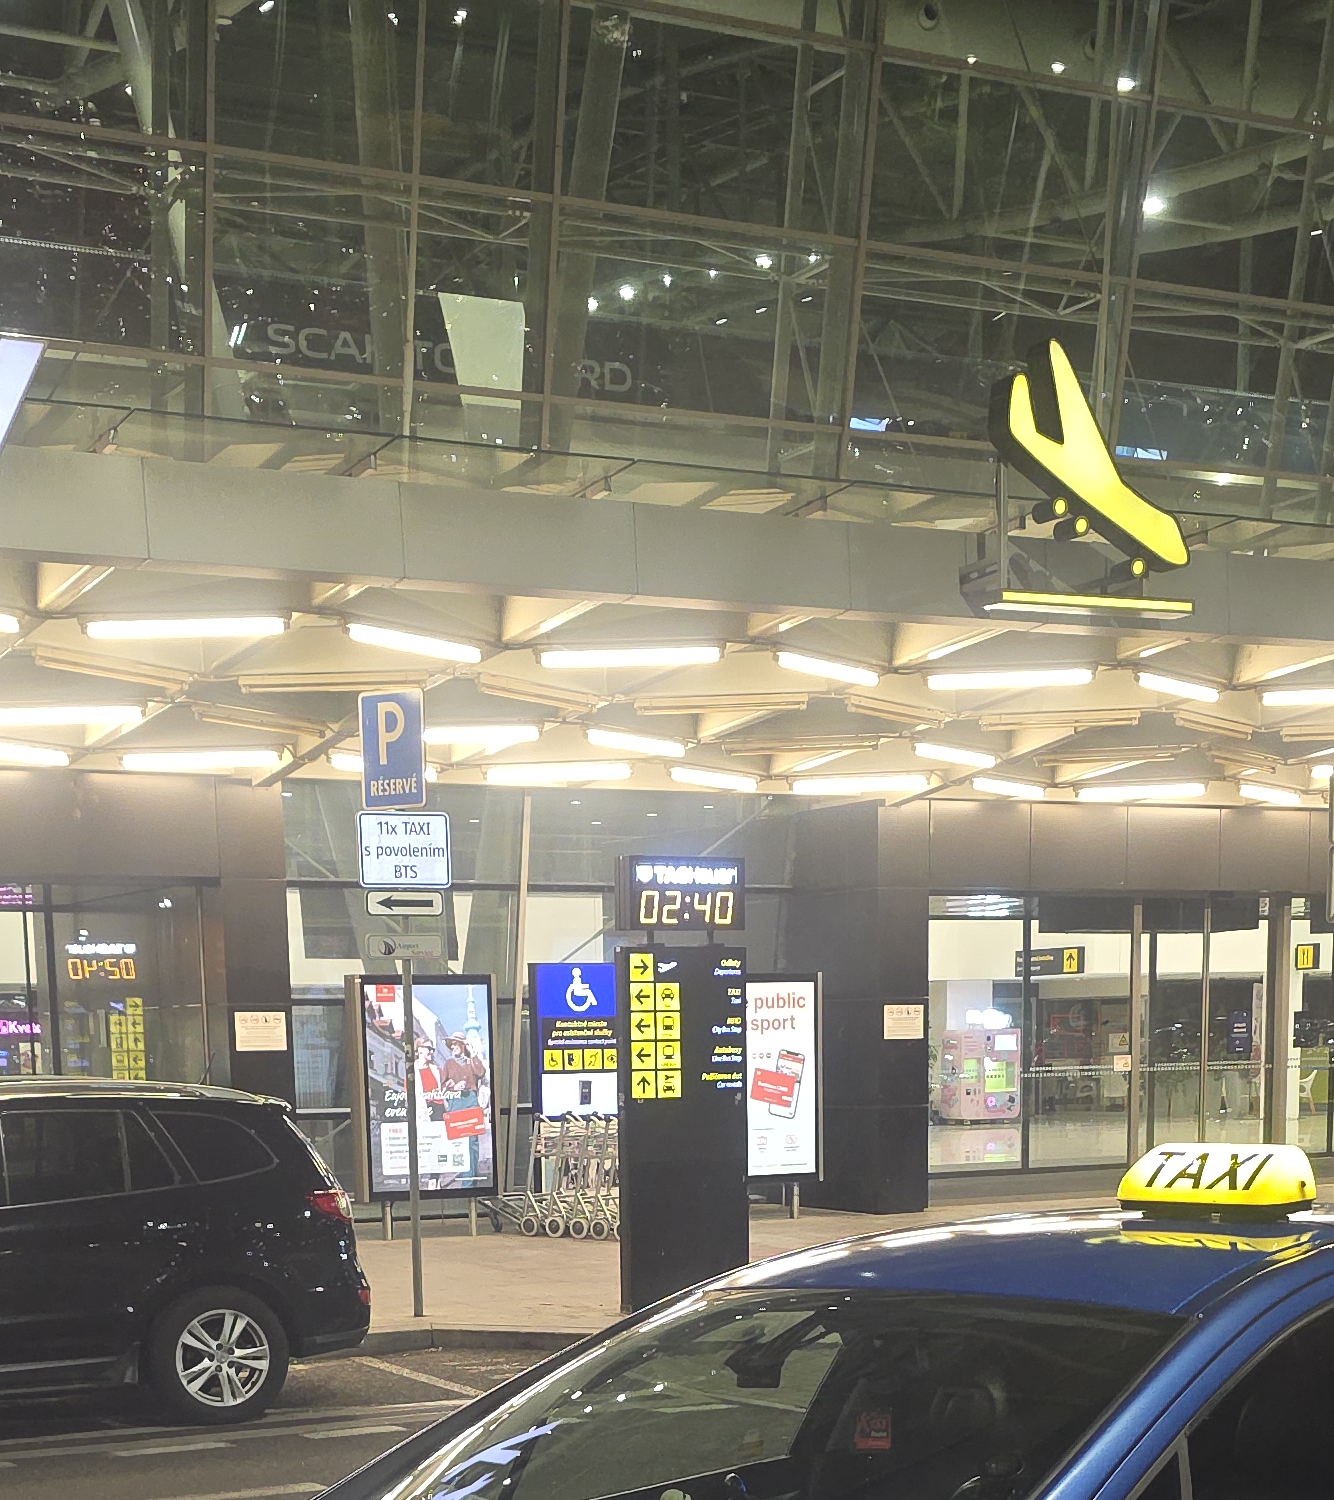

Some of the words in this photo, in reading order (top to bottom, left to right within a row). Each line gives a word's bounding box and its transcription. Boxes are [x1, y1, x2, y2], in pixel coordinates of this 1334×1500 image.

[377, 701, 405, 765] P
[370, 773, 418, 797] RÉSERVÉ
[377, 821, 398, 836] 11x
[402, 821, 431, 836] TAXI
[364, 846, 371, 857] s
[376, 842, 445, 858] povolením
[394, 865, 418, 879] BTS
[640, 890, 734, 925] 02:40
[754, 992, 806, 1013] public
[747, 1015, 796, 1035] sport
[1145, 1151, 1275, 1191] TAXI
